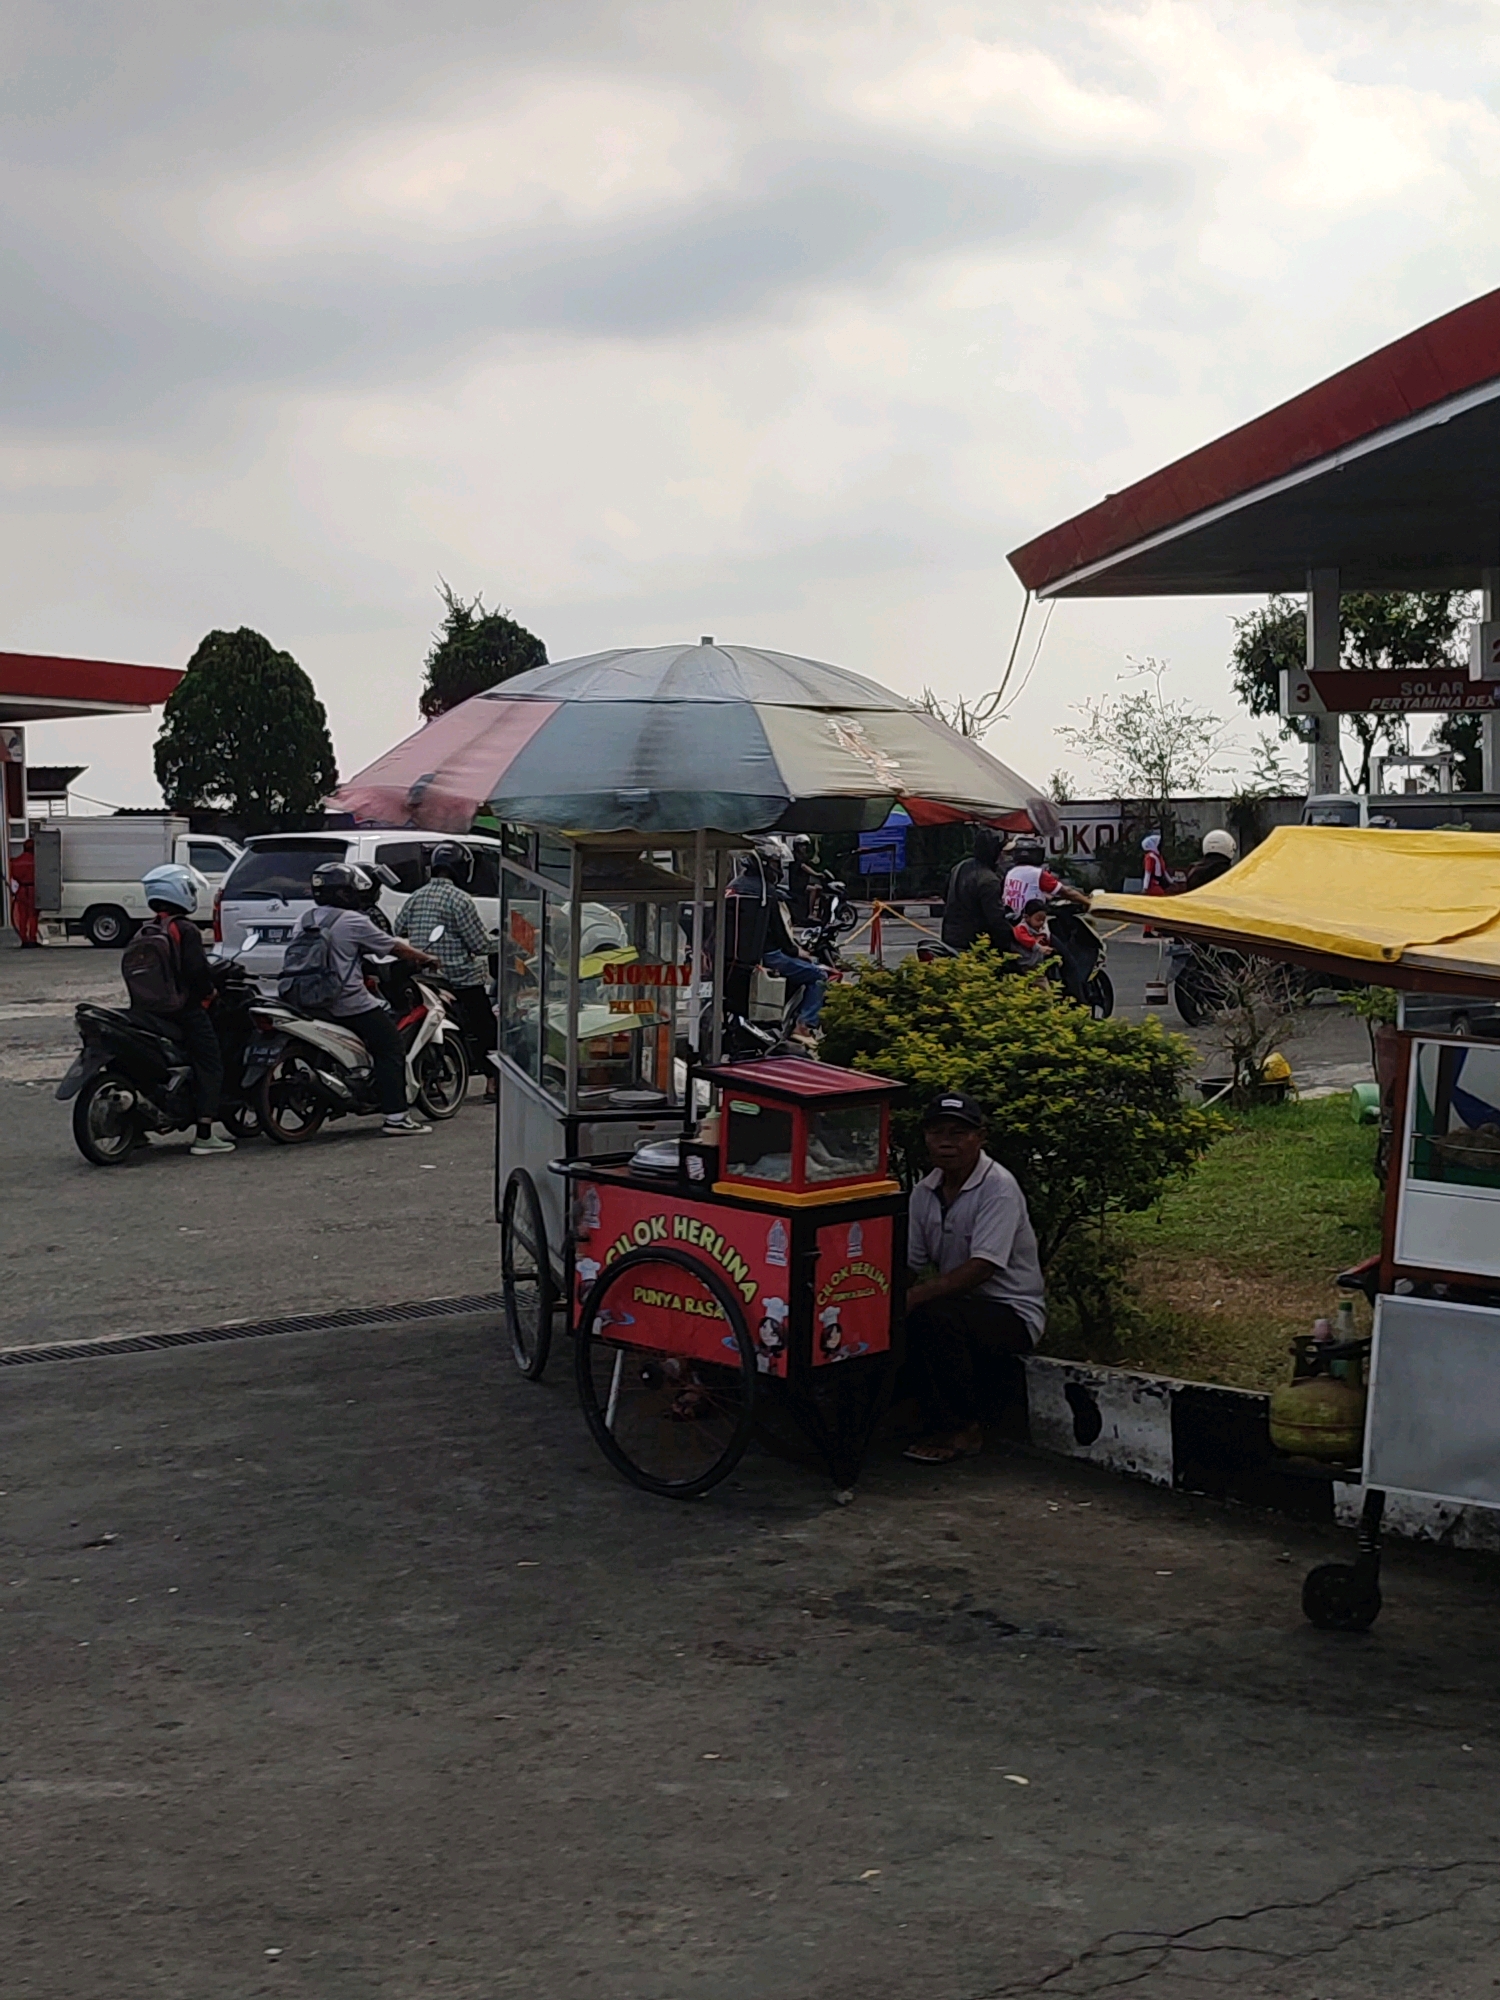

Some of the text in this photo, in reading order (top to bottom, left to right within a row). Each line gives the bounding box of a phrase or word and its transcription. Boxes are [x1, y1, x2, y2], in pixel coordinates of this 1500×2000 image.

[1297, 684, 1310, 702] 3
[1400, 681, 1464, 696] SOLAR
[1369, 697, 1463, 710] PERTAMINA
[603, 963, 692, 986] SIOMAY
[605, 1214, 759, 1304] CILOK HERLINA
[633, 1286, 726, 1320] PUNYA RASA
